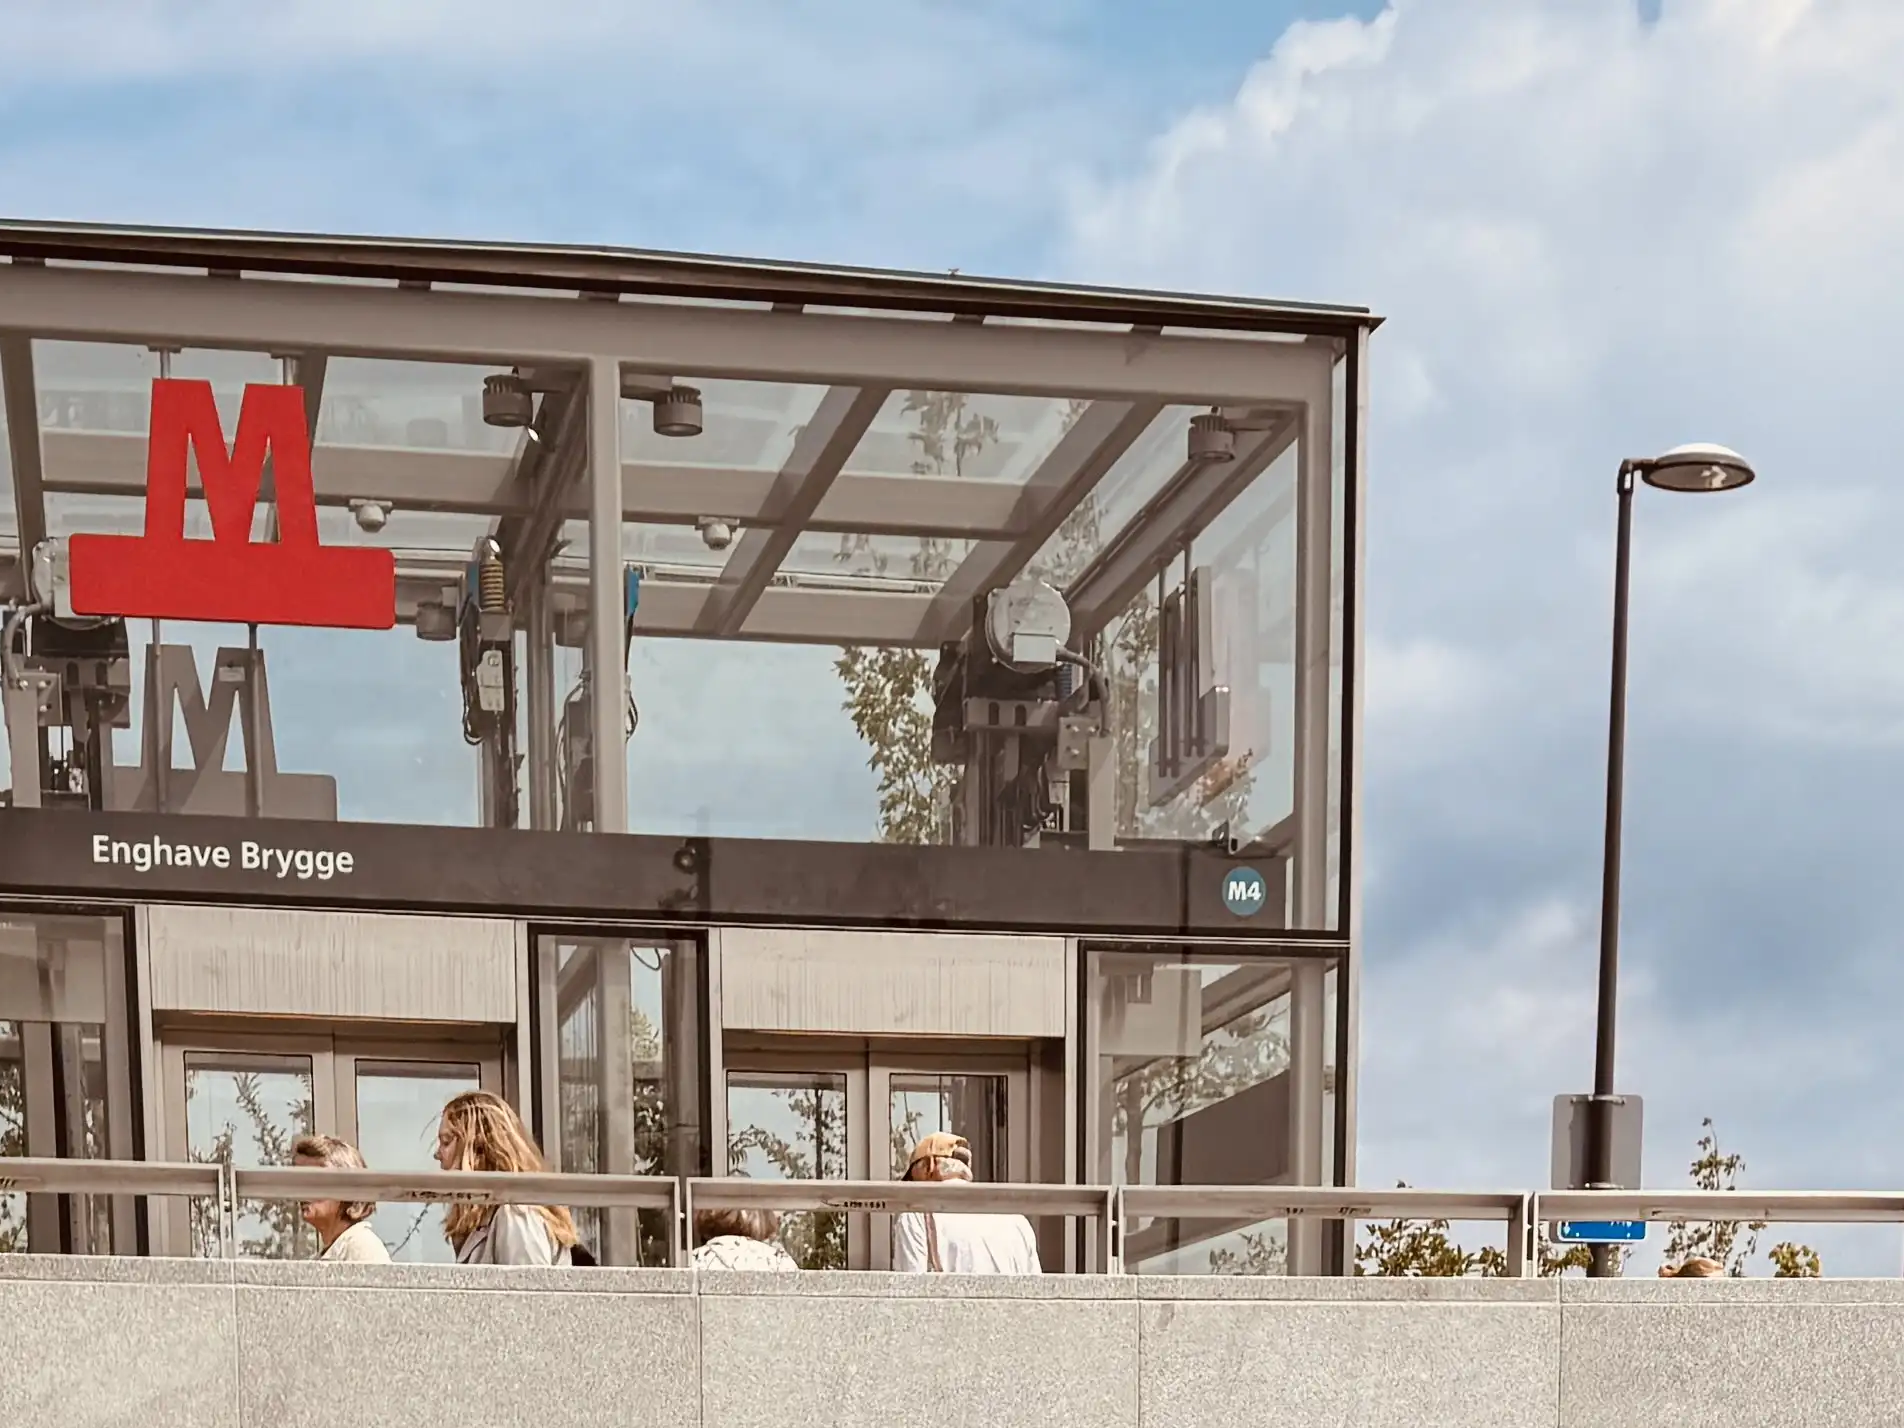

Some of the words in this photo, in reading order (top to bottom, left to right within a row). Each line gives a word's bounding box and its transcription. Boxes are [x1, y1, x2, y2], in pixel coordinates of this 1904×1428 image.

[92, 834, 231, 872] Enghave
[241, 841, 354, 880] Brygge
[1227, 880, 1262, 901] M4
